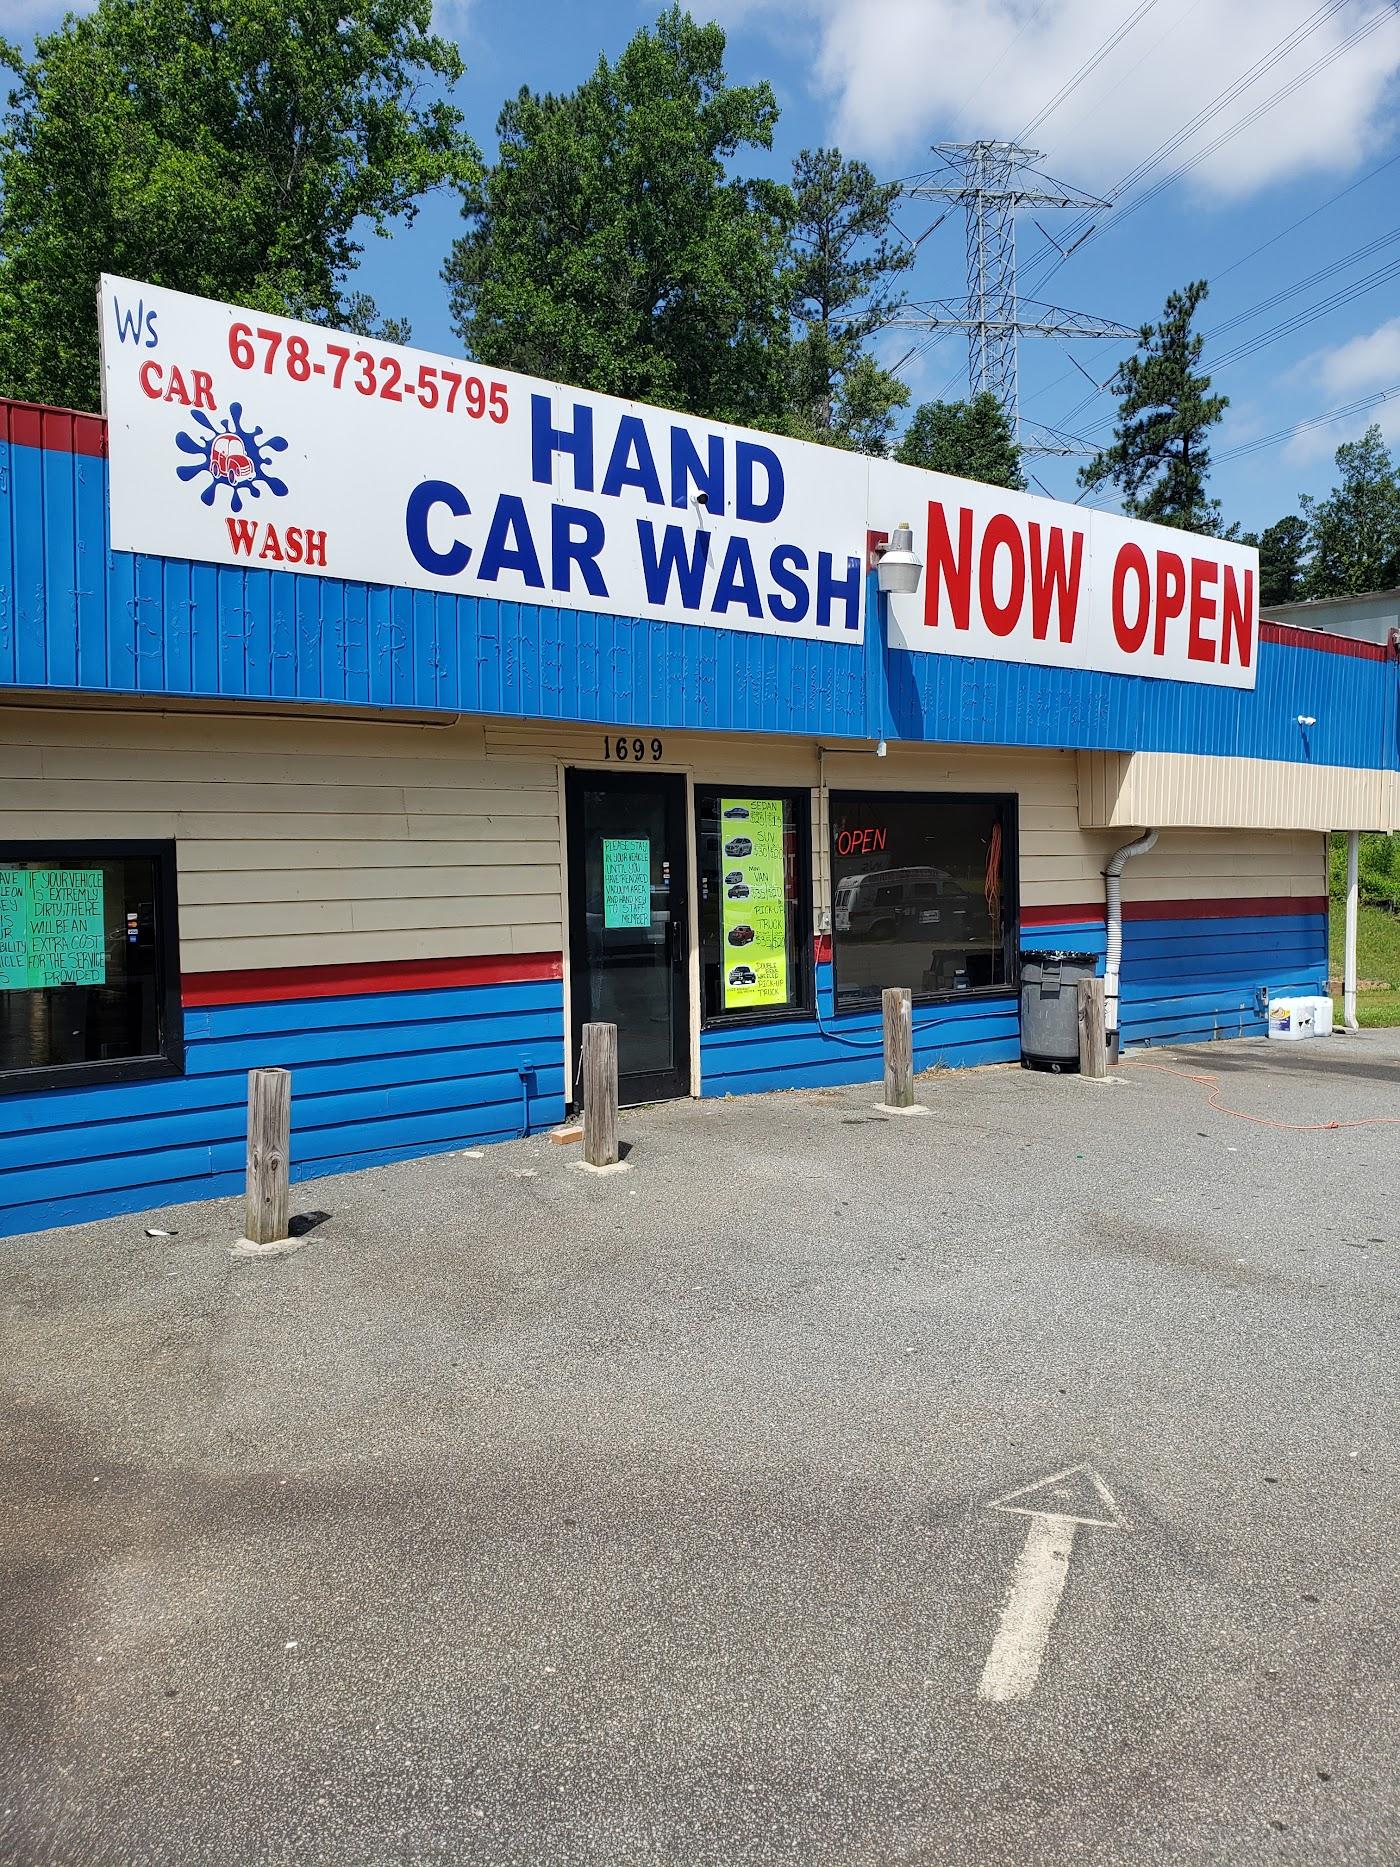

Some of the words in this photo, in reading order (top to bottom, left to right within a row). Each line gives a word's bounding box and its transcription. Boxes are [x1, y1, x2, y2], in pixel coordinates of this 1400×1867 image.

[228, 322, 509, 424] 678-732-5795
[138, 360, 217, 411] CAR
[530, 393, 785, 524] HAND
[225, 517, 327, 567] WASH
[405, 479, 610, 598] CAR
[636, 517, 861, 630] WASH
[924, 500, 1084, 644] NOW
[1111, 542, 1253, 668] OPEN
[604, 735, 663, 761] 1699
[750, 801, 777, 811] SEDAN
[757, 830, 775, 842] SUV
[837, 827, 888, 856] OPEN
[605, 841, 629, 851] PLEASE
[631, 841, 648, 852] STAY
[606, 864, 626, 874] UNTIL
[753, 872, 769, 882] VAN
[41, 872, 68, 889] YOUR
[69, 872, 103, 888] VEHICLE
[50, 888, 99, 901] EXTREMLY
[64, 901, 101, 916] THERE
[606, 904, 618, 913] TO
[622, 904, 645, 914] STAFF
[30, 921, 55, 934] WILL
[56, 919, 69, 934] BE
[72, 919, 88, 932] AN
[32, 936, 69, 952] EXTRA
[71, 934, 103, 950] COST
[28, 953, 46, 969] FOR
[46, 952, 67, 969] THE
[68, 952, 104, 969] SERVICE
[41, 969, 100, 985] PROVIDED
